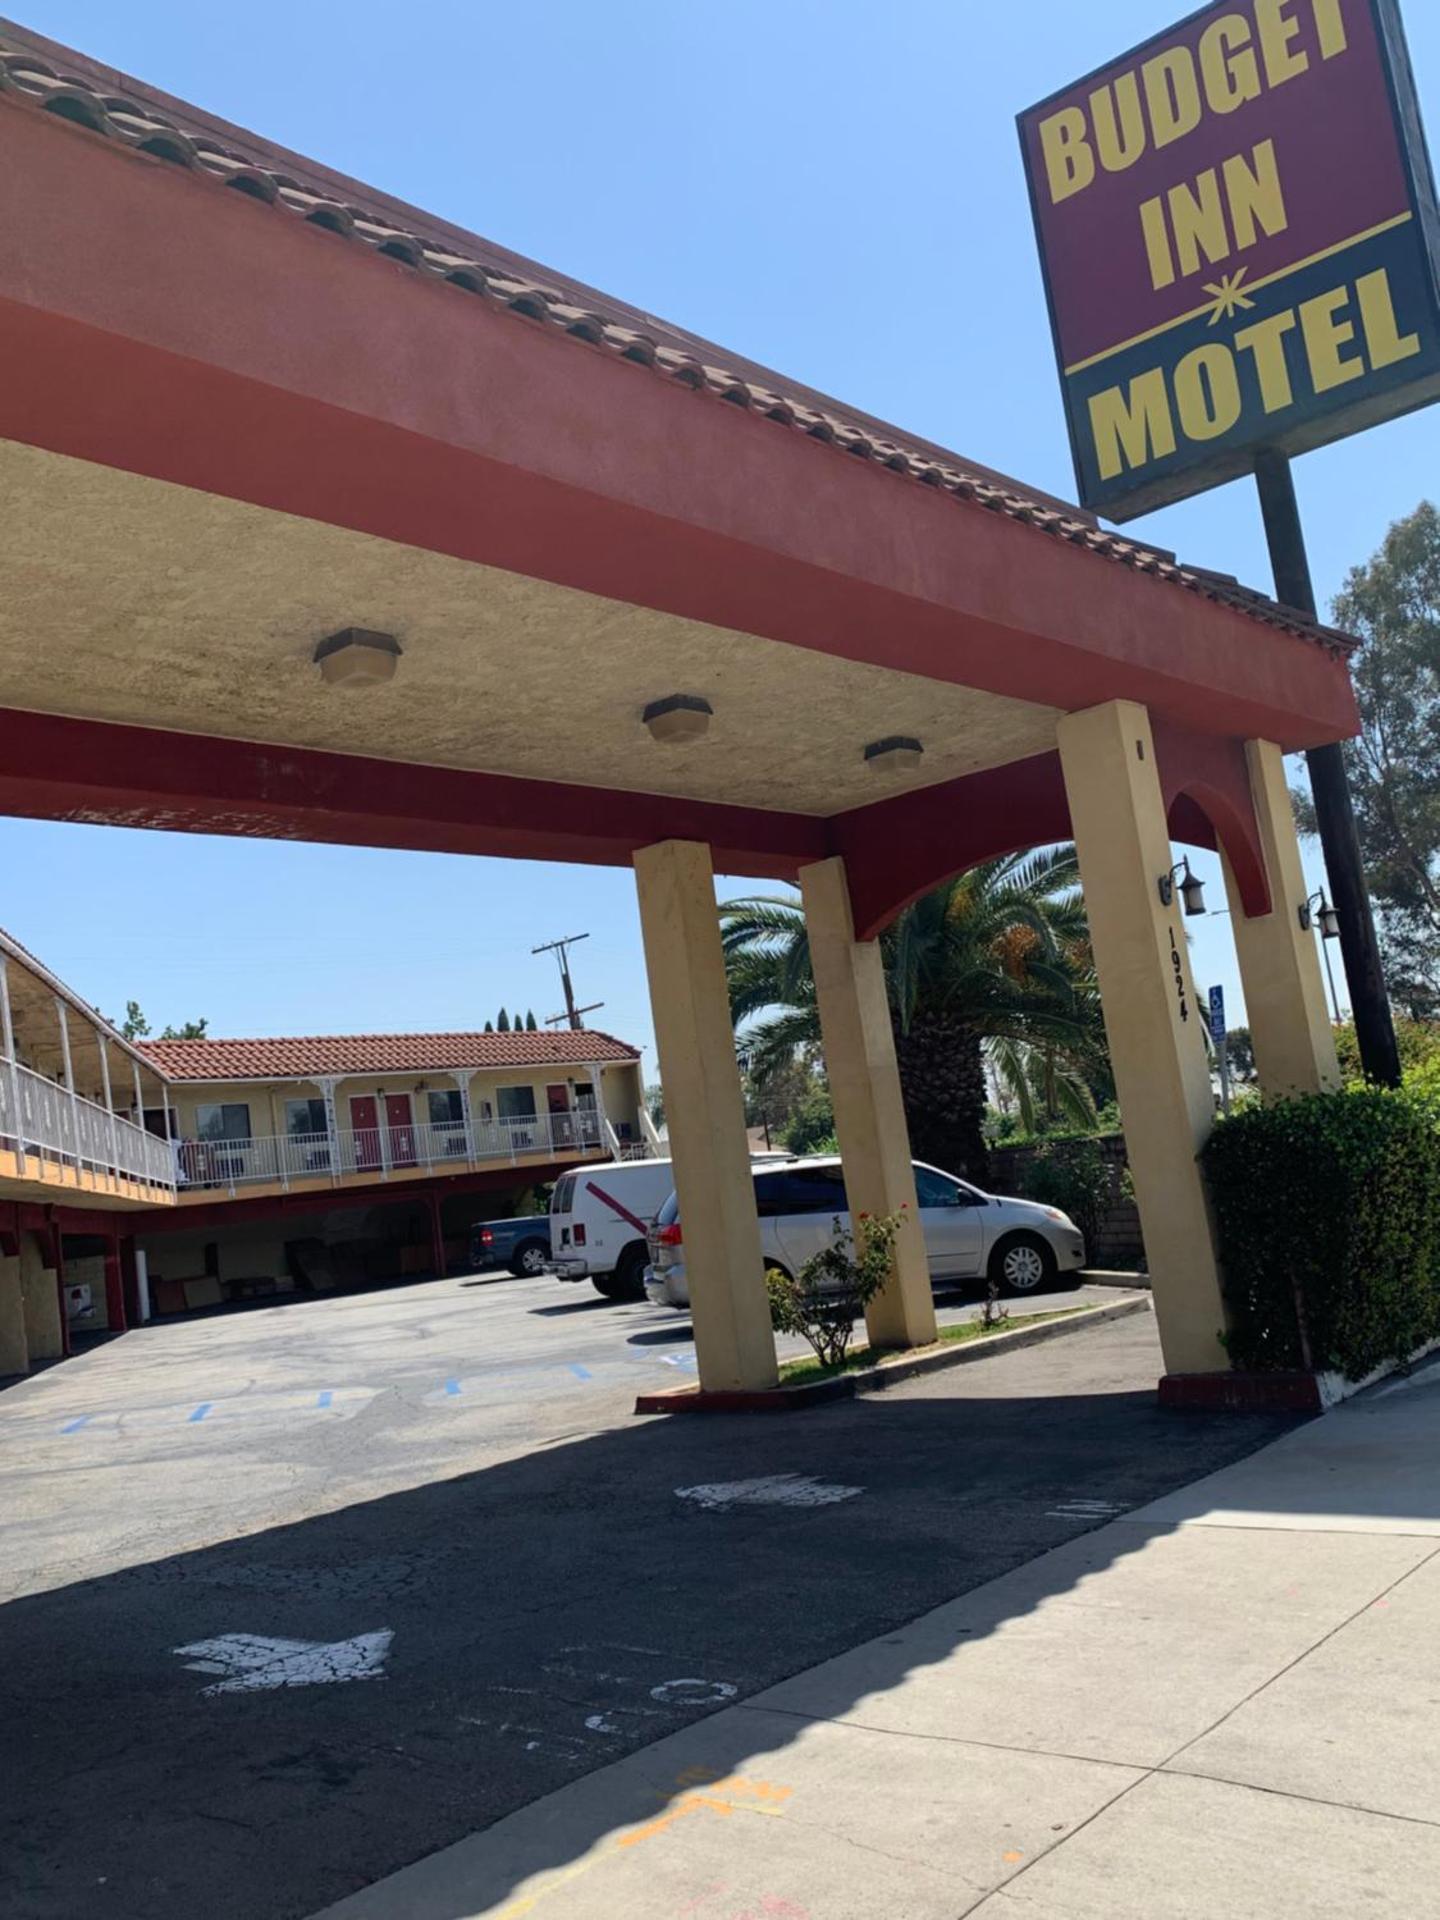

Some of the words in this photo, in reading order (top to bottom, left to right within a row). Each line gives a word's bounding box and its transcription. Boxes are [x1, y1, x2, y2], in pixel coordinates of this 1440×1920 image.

[1139, 138, 1288, 291] INN
[1088, 267, 1420, 480] MOTEL
[1169, 927, 1188, 1022] 1924
